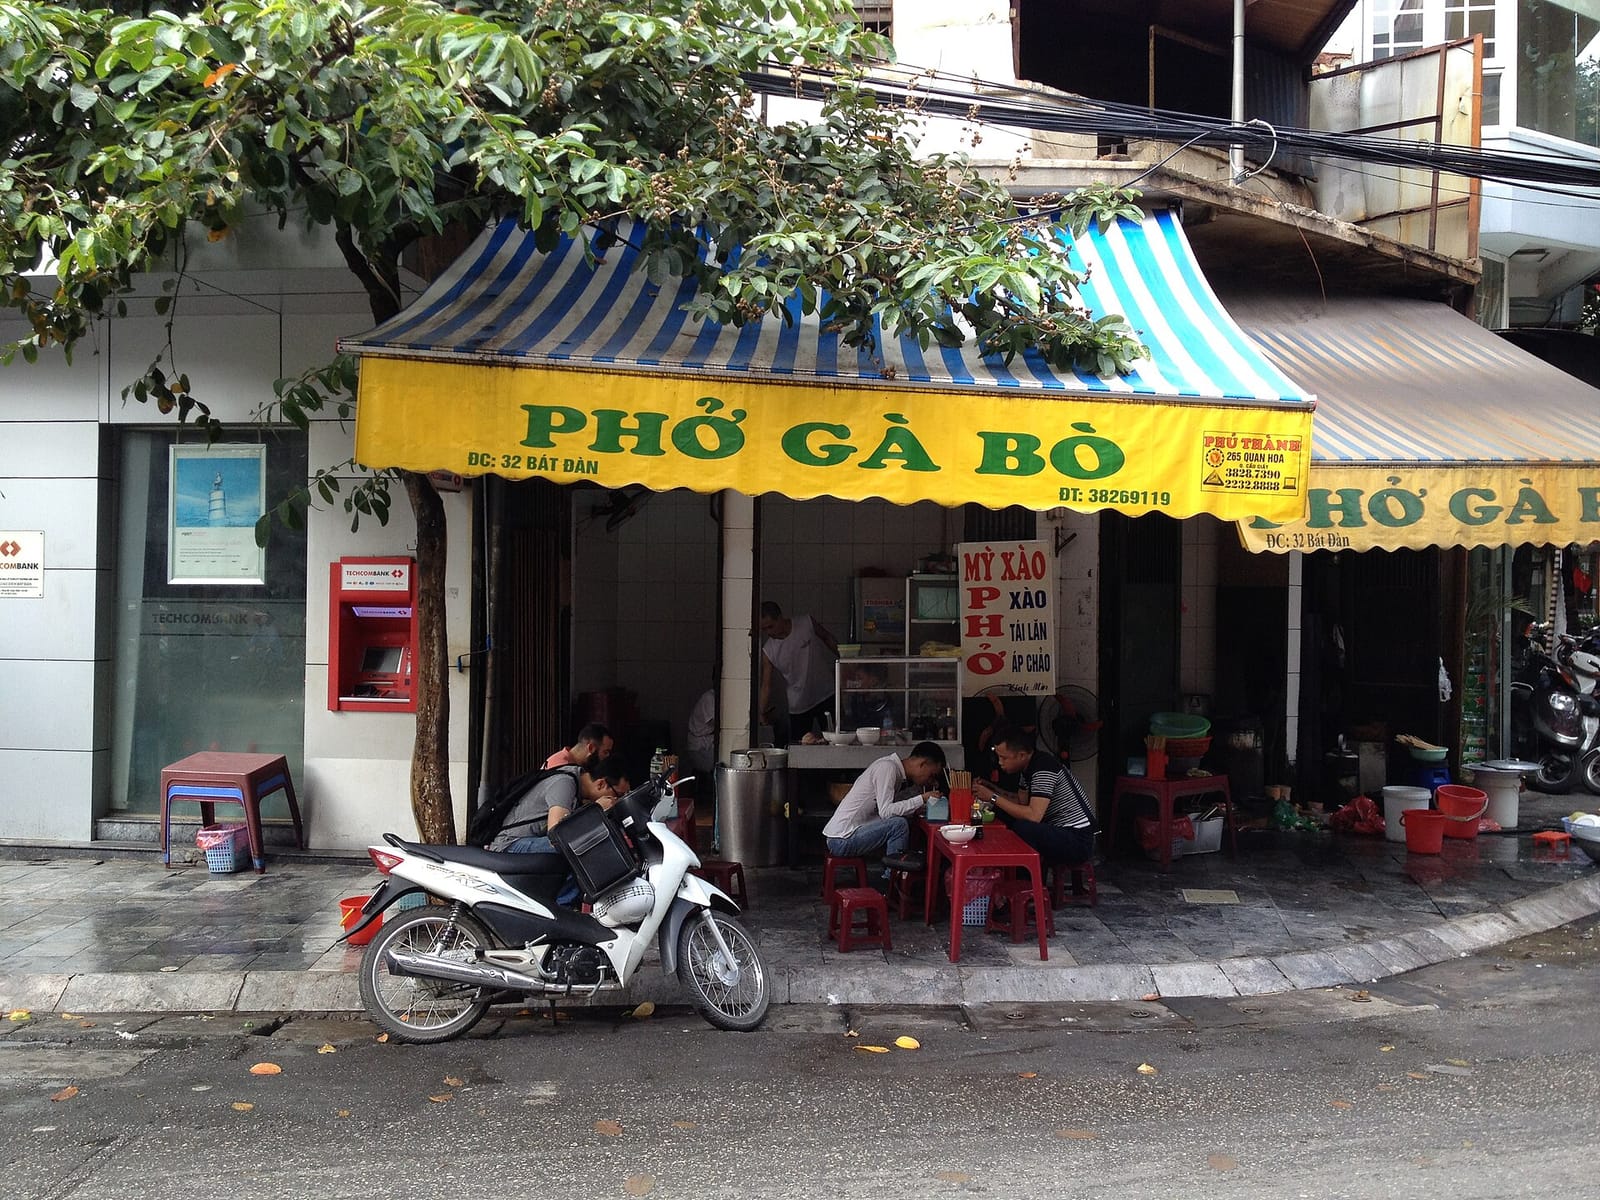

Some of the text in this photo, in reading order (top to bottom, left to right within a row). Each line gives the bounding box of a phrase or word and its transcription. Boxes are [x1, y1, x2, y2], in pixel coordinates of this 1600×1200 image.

[519, 397, 1125, 480] PHỞ GÀ BÒ
[467, 451, 599, 475] ĐC: 32 BÁT ĐÀN
[1226, 451, 1284, 464] 265 QUAN HOA
[1224, 479, 1280, 491] 2232.8888
[1225, 468, 1281, 479] 3828.7390
[1059, 487, 1171, 506] ĐT: 38269119
[1248, 476, 1428, 529] HỞ
[1449, 478, 1560, 526] GÀ
[1266, 532, 1350, 549] ĐC: 32 Bát Đàn
[964, 544, 1047, 582] MỲ XÀO
[1008, 586, 1047, 610] XÀO
[151, 612, 249, 625] TECHCOMBANK
[964, 586, 1008, 675] PHỞ
[1009, 618, 1048, 642] TÁI LĂN
[1011, 646, 1051, 673] ÁP CHẢO
